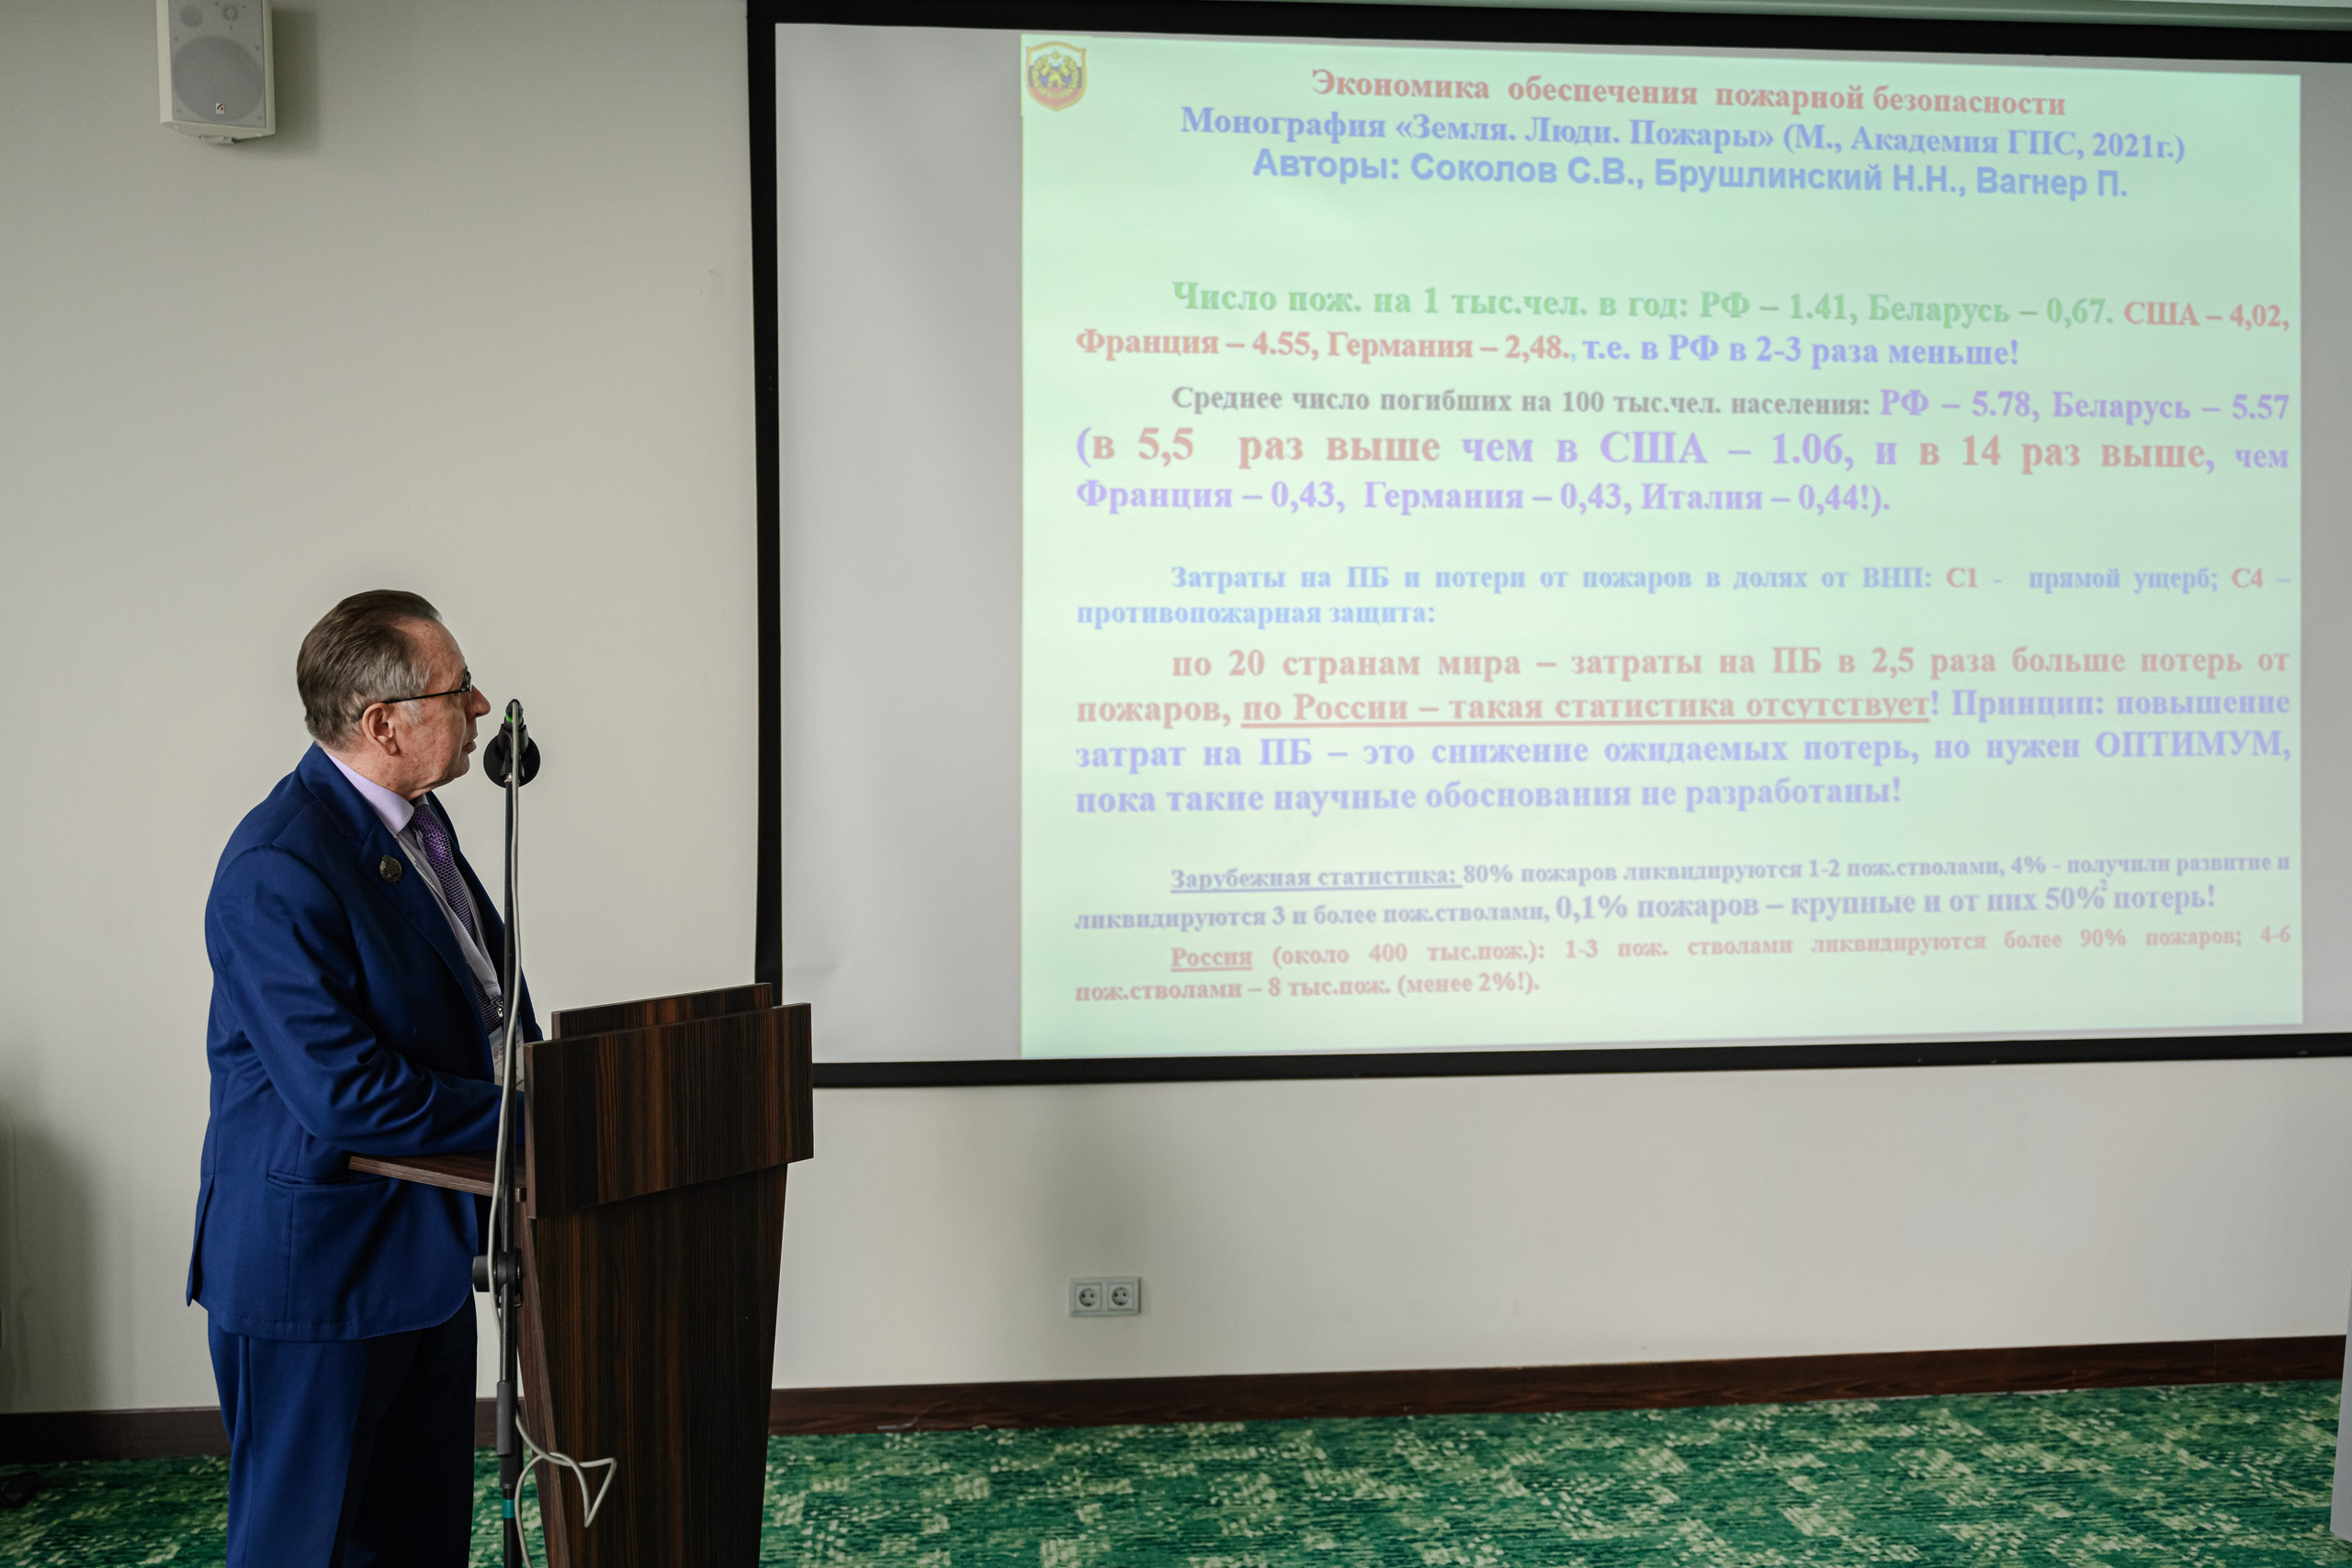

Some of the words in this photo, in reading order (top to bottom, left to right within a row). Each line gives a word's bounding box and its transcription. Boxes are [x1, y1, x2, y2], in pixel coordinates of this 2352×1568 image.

[1310, 67, 1491, 100] Экономика
[1507, 73, 1699, 107] обеспечения
[1715, 84, 1865, 117] пожарной
[1871, 84, 2067, 117] безопасности
[1180, 105, 1387, 146] Монография
[1395, 112, 1518, 142] «Земля.
[1523, 115, 1621, 146] Люди.
[1628, 118, 1775, 155] Пожары»
[1782, 122, 1843, 154] (М.,
[1849, 125, 1999, 155] Академия
[2007, 128, 2086, 161] ГПС,
[2091, 130, 2187, 165] 2021г.)
[1251, 147, 1400, 186] Авторы:
[1409, 151, 1558, 185] Соколов
[1566, 155, 1645, 191] С.В.,
[1654, 157, 1883, 195] Брушлинский
[1892, 163, 1966, 199] Н.Н.,
[1975, 164, 2089, 204] Вагнер
[2097, 168, 2129, 198] П.
[1170, 279, 1279, 312] Число
[1287, 290, 1363, 313] пож.
[1373, 291, 1413, 314] на
[1628, 296, 1689, 320] год:
[1699, 289, 1751, 320] РФ
[1790, 292, 1860, 326] 1.41,
[1868, 292, 2012, 331] Беларусь
[2045, 297, 2114, 330] 0,67.
[2122, 299, 2201, 327] США
[2229, 302, 2290, 333] 4,02,
[1074, 327, 1220, 362] Франция
[1251, 329, 1319, 361] 4.55,
[1327, 330, 1475, 366] Германия
[1580, 339, 1632, 361] т.е.
[1668, 333, 1720, 362] РФ
[1755, 333, 1803, 363] 2-3
[1810, 343, 1879, 371] раза
[1887, 338, 2019, 367] меньше!
[1170, 385, 1283, 416] Среднее
[1290, 391, 1371, 412] число
[1379, 387, 1513, 412] погибших
[1521, 393, 1552, 413] на
[1562, 389, 1606, 413] 100
[1730, 396, 1871, 416] населения:
[1879, 388, 1931, 417] РФ
[1972, 389, 2041, 423] 5.78,
[2051, 390, 2192, 427] Беларусь
[2232, 392, 2290, 421] 5.57
[1075, 425, 1116, 468] (в
[1136, 426, 1195, 468] 5,5
[1238, 435, 1305, 470] раз
[1326, 436, 1442, 463] выше
[1461, 437, 1534, 464] чем
[1599, 429, 1709, 465] США
[1771, 431, 1855, 472] 1.06,
[1962, 433, 2002, 468] 14
[2020, 442, 2082, 477] раз
[2100, 443, 2215, 475] выше,
[2234, 447, 2290, 469] чем
[1075, 479, 1234, 516] Франция
[1270, 479, 1347, 515] 0,43,
[1363, 480, 1525, 517] Германия
[1558, 481, 1634, 516] 0,43,
[1641, 481, 1764, 512] Италия
[1797, 483, 1891, 518] 0,44!).
[1170, 564, 1287, 596] Затраты
[1346, 565, 1390, 590] ПБ
[1434, 570, 1527, 596] потери
[1581, 570, 1694, 596] пожаров
[1731, 570, 1809, 592] долях
[1861, 565, 1932, 590] ВНП:
[2028, 567, 2122, 596] прямой
[2132, 566, 2219, 596] ущерб;
[1077, 604, 1323, 632] противопожарная
[1328, 605, 1436, 626] защита:
[1171, 655, 1214, 678] по
[1228, 648, 1266, 678] 20
[1281, 655, 1421, 685] странам
[1438, 654, 1521, 683] мира
[1570, 653, 1703, 683] затраты
[1719, 653, 1757, 675] на
[1771, 645, 1823, 675] ПБ
[1871, 646, 1916, 680] 2,5
[1929, 652, 1997, 682] раза
[2010, 644, 2127, 673] больше
[2139, 652, 2245, 681] потерь
[2256, 652, 2291, 672] от
[1076, 700, 1233, 730] пожаров,
[1241, 700, 1283, 721] по
[1293, 693, 1409, 720] России
[1447, 698, 1544, 719] такая
[1554, 697, 1736, 718] статистика
[1745, 688, 1940, 716] отсутствует!
[1951, 688, 2105, 724] Принцип:
[2115, 694, 2291, 714] повышение
[1074, 746, 1186, 776] затрат
[1203, 745, 1242, 767] на
[1259, 737, 1314, 766] ПБ
[1362, 744, 1416, 766] это
[1430, 742, 1589, 764] снижение
[1603, 740, 1789, 765] ожидаемых
[1803, 739, 1920, 768] потерь,
[1934, 739, 1972, 761] но
[1985, 738, 2081, 767] нужен
[2094, 728, 2291, 762] ОПТИМУМ,
[1076, 791, 1158, 815] пока
[1165, 790, 1264, 813] такие
[1272, 788, 1418, 819] научные
[1424, 779, 1632, 809] обоснования
[1640, 785, 1678, 807] не
[1684, 775, 1902, 814] разработаны!
[1170, 866, 1313, 887] Зарубежная
[1317, 868, 1456, 886] статистика:
[1461, 863, 1514, 883] 80%
[1521, 865, 1618, 888] пожаров
[1622, 863, 1804, 886] ликвидируются
[1808, 857, 1842, 879] 1-2
[2009, 854, 2048, 874] 4%
[2066, 857, 2171, 879] получили
[2175, 855, 2273, 878] развитие
[1072, 909, 1268, 934] ликвидируются
[1313, 903, 1378, 925] более
[1555, 893, 1629, 925] 0,1%
[1635, 897, 1760, 926] пожаров
[1790, 894, 1917, 924] крупные
[1985, 892, 2039, 913] них
[2113, 883, 2216, 917] потерь!
[1169, 946, 1254, 971] Россия
[1272, 944, 1351, 968] (около
[1367, 942, 1409, 964] 400
[1565, 938, 1600, 960] 1-3
[1616, 941, 1669, 959] пож.
[1686, 938, 1794, 957] стволами
[1809, 934, 1987, 958] ликвидируются
[2002, 929, 2063, 951] более
[2078, 927, 2128, 949] 90%
[2144, 930, 2244, 952] пожаров;
[2259, 924, 2292, 944] 4-6
[1396, 973, 1474, 999] (менее
[1477, 970, 1541, 996] 2%!).
